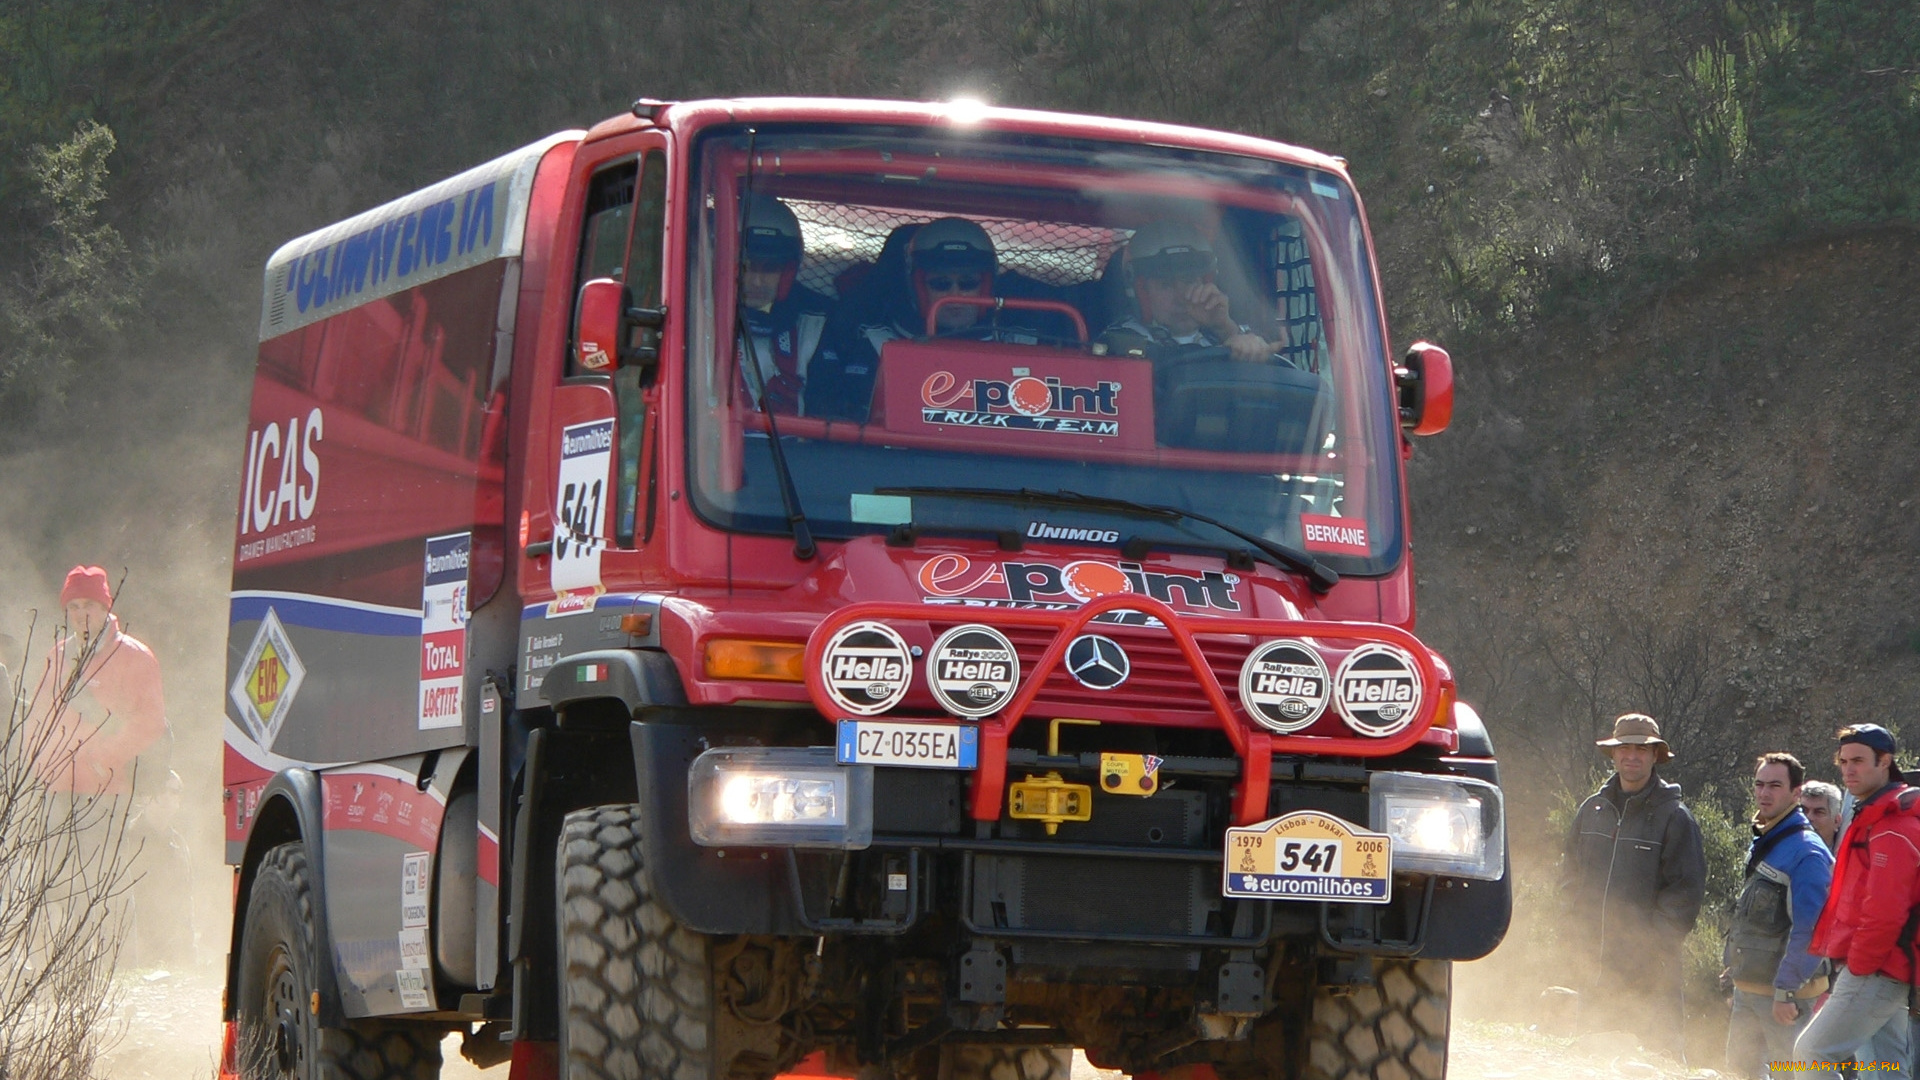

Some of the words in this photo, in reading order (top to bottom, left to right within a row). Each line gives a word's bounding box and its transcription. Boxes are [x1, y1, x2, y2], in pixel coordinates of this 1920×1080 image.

[922, 409, 1010, 428] TRUCK
[1032, 417, 1119, 437] TEAM
[241, 408, 323, 535] ICAS
[556, 479, 602, 561] 541
[240, 540, 265, 562] DRAWER
[265, 525, 316, 555] MANUFACTURING
[1305, 524, 1366, 546] BERKANE
[949, 650, 980, 660] Rallye
[833, 657, 901, 680] Hella
[944, 661, 1006, 681] Hella
[1263, 663, 1292, 674] Rallye
[969, 688, 999, 699] HELLA
[1256, 674, 1317, 696] Hella
[1346, 680, 1411, 702] Hella
[422, 686, 460, 718] LOCTITE
[1281, 702, 1309, 714] HELLA
[1275, 817, 1307, 835] Lisboa
[1318, 819, 1345, 838] Dakar
[1236, 836, 1262, 848] 1979
[1356, 841, 1383, 853] 2006
[1281, 843, 1337, 873] 541
[1260, 877, 1373, 896] euromilhões
